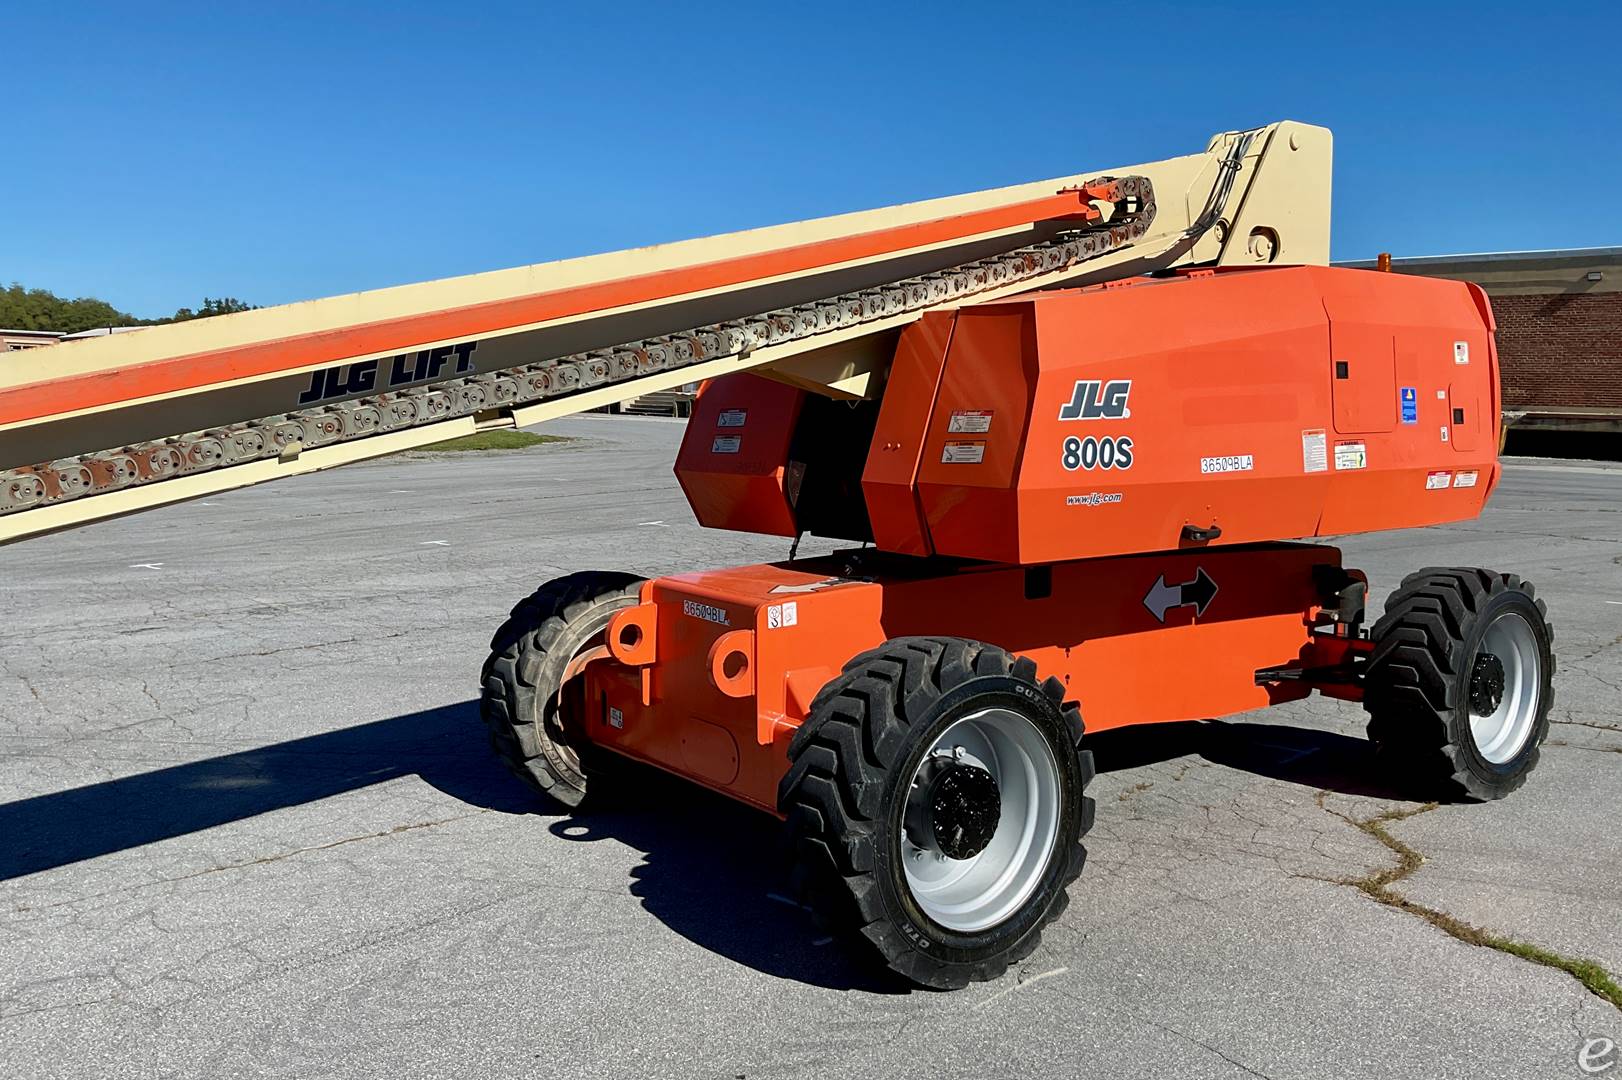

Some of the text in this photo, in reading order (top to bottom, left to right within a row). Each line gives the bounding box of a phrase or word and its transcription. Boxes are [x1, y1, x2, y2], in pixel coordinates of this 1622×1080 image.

[298, 341, 477, 405] JLG LIFT
[1059, 380, 1131, 420] JLG
[1062, 435, 1134, 470] 800S
[1202, 456, 1252, 472] 36509BLA
[1067, 492, 1122, 506] www.jlg.com
